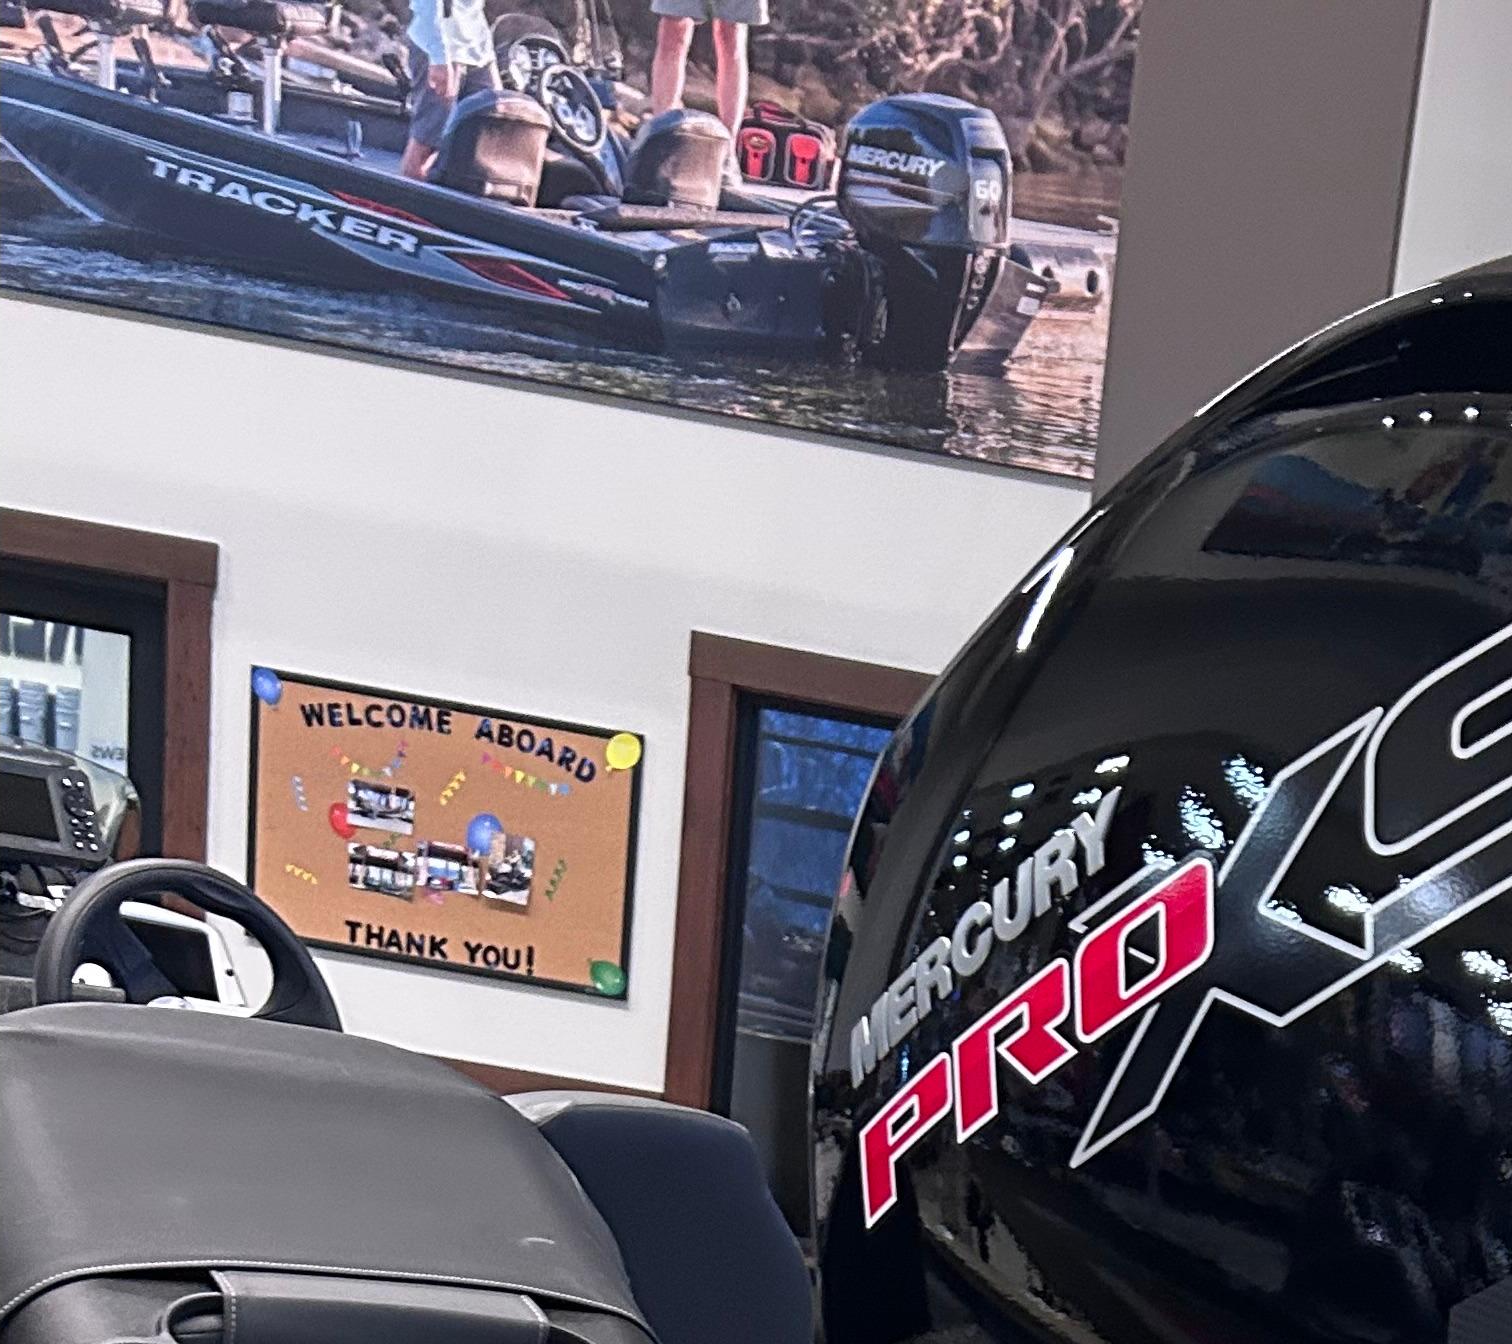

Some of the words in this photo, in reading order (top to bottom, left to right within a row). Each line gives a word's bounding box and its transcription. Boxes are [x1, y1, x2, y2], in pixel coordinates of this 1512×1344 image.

[145, 154, 422, 257] TRACKER
[846, 143, 946, 177] MERCURY
[299, 701, 453, 736] WELCOME
[474, 716, 597, 784] ABOARD
[345, 919, 448, 964] THANK
[465, 936, 536, 976] YOU!
[849, 785, 1122, 1090] MERCURY
[859, 855, 1215, 1229] PRO
